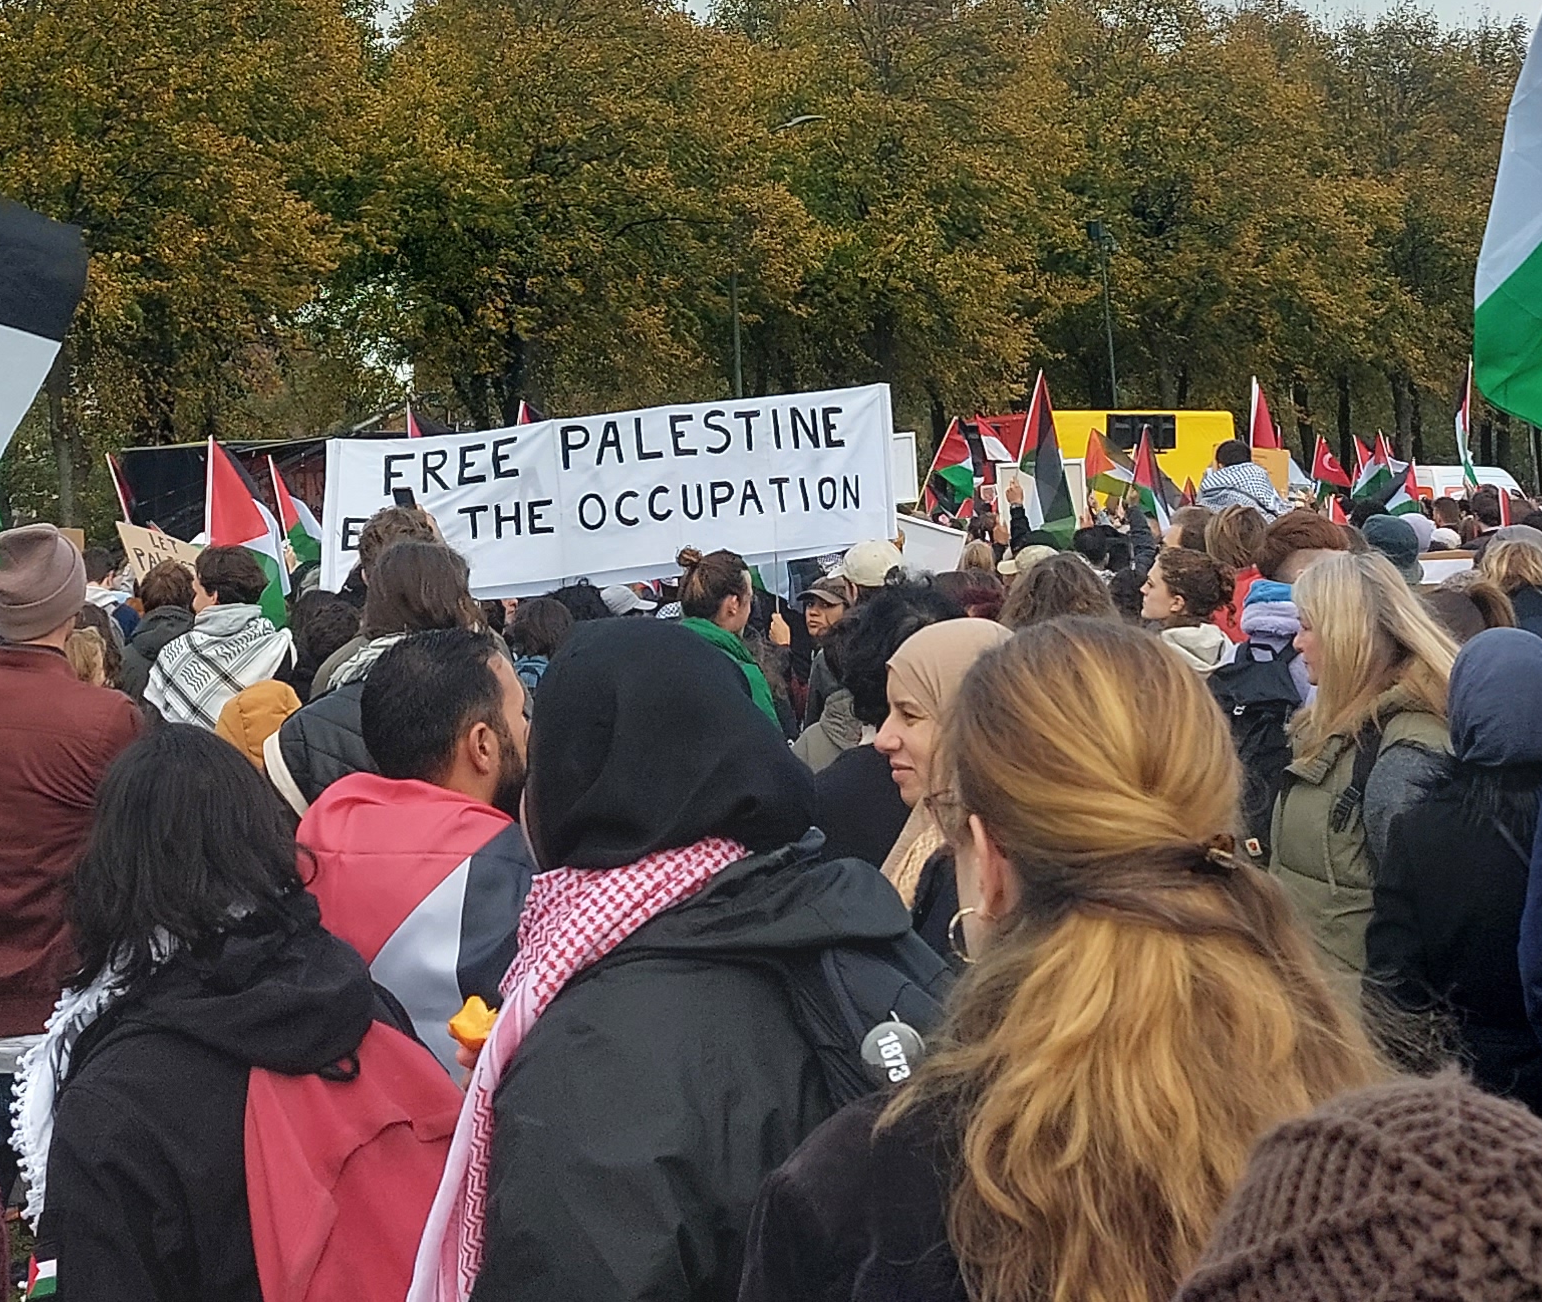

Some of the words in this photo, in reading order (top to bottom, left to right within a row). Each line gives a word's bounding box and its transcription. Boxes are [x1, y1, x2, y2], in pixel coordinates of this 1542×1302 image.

[383, 436, 520, 496] FREE
[560, 406, 846, 470] PALESTINE
[457, 499, 555, 540] THE
[577, 474, 860, 531] OCCUPATION
[147, 531, 179, 554] LET
